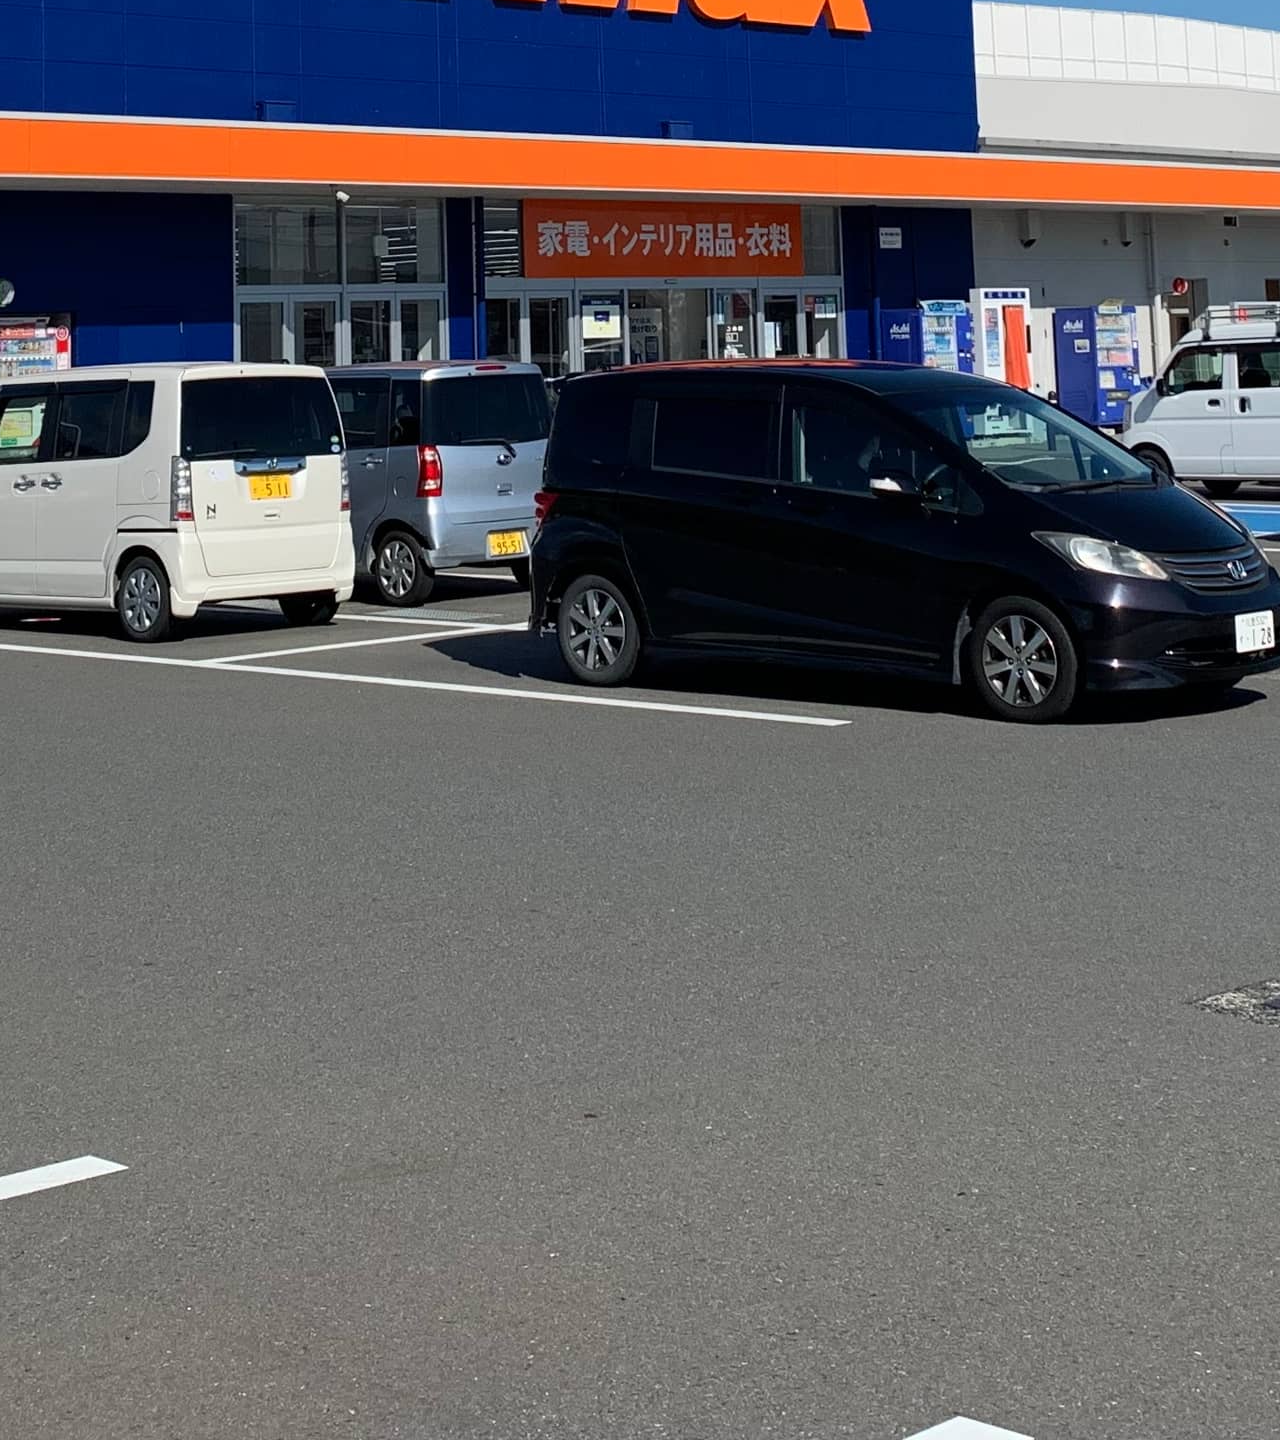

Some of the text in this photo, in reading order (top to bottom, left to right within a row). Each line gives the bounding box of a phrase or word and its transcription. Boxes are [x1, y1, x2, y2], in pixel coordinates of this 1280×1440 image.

[537, 220, 792, 257] 家電・インテリア用品・衣料
